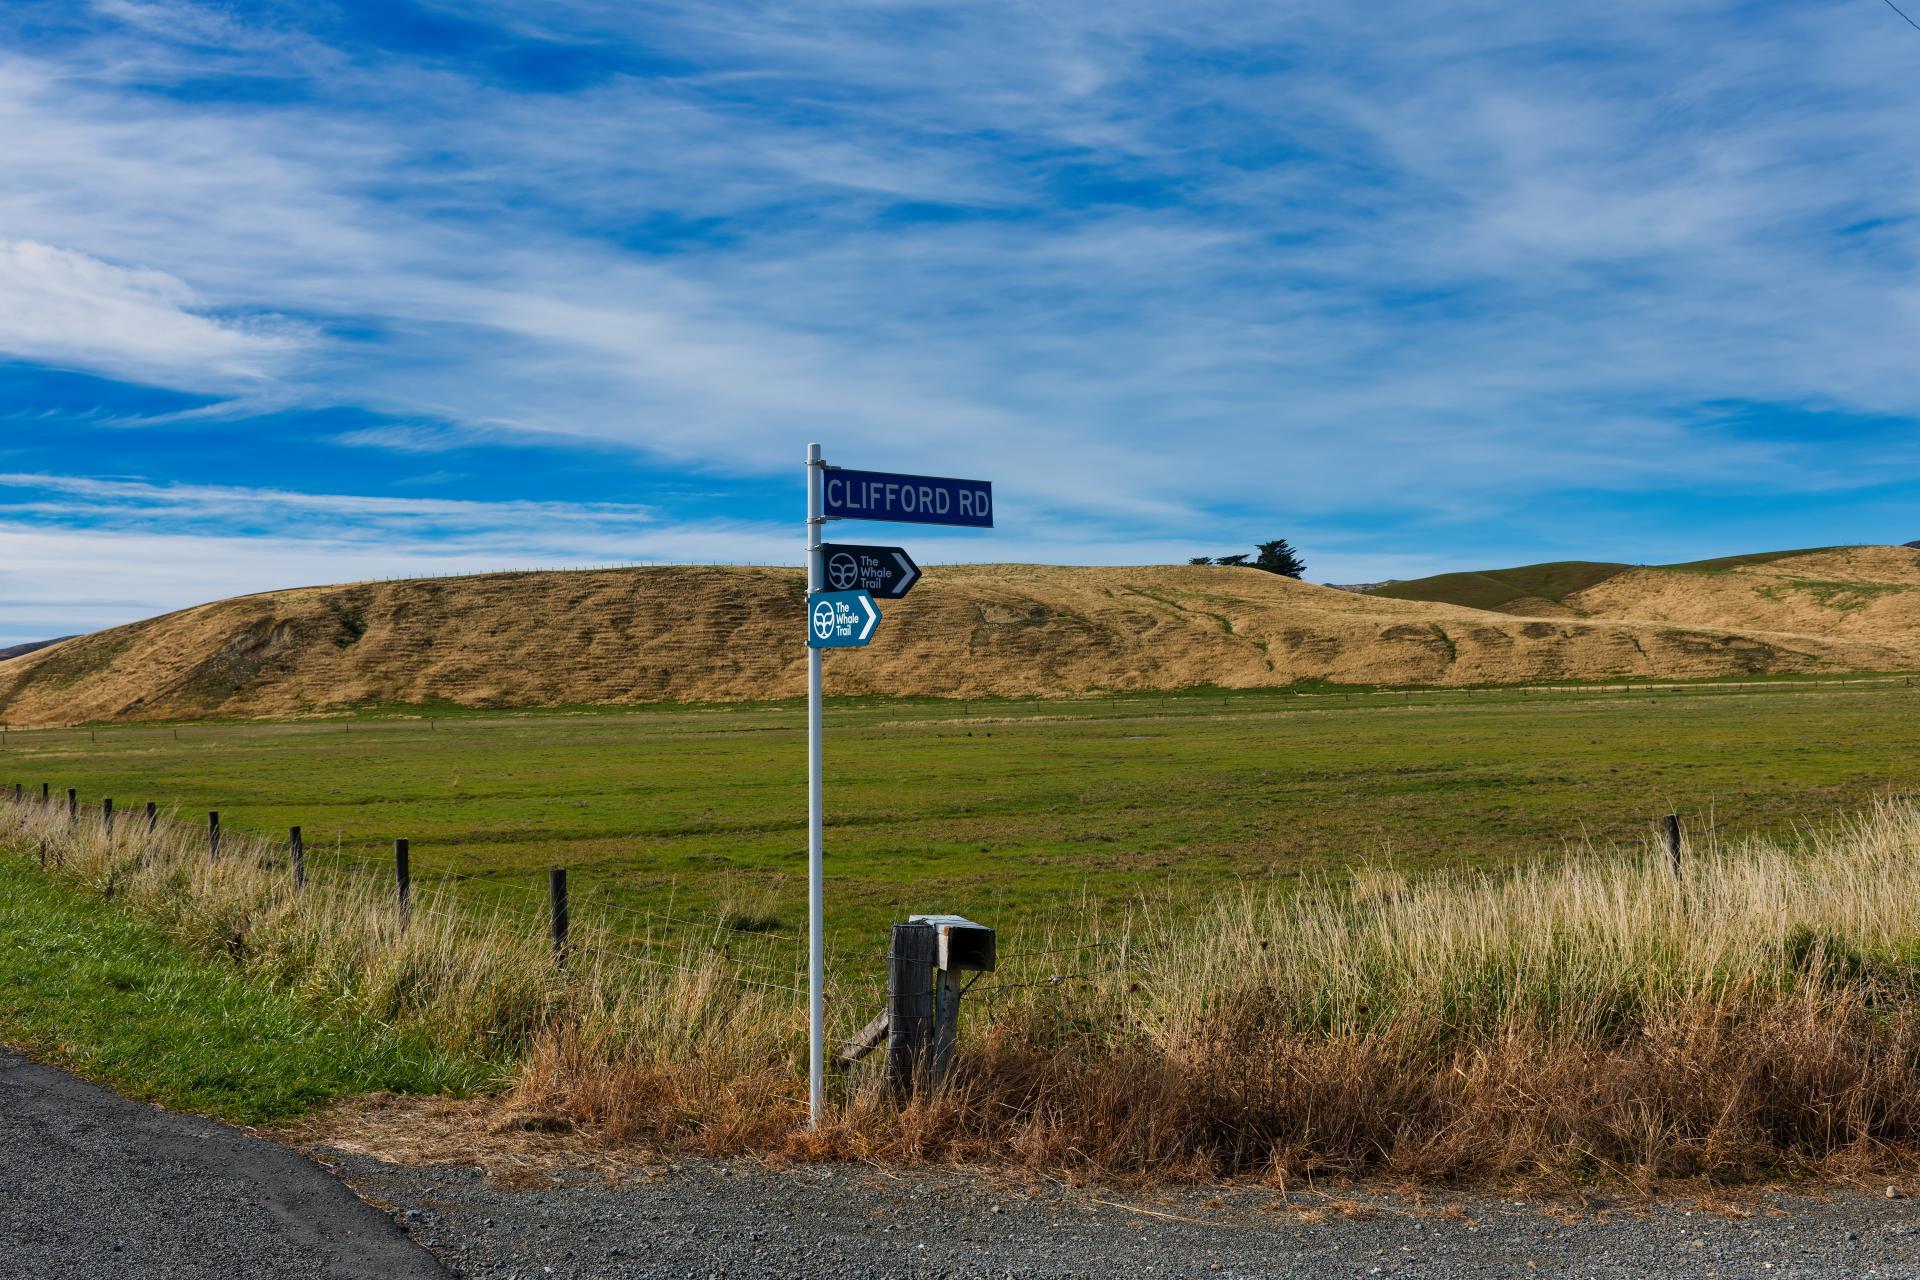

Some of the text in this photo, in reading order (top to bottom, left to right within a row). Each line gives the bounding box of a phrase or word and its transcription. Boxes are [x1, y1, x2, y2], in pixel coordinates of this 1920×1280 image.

[827, 479, 990, 517] CLIFFORD RD
[860, 555, 879, 567] The
[860, 567, 892, 578] Whale
[860, 578, 881, 589] Trail
[835, 601, 850, 613] The
[836, 612, 859, 624] Whale
[836, 624, 852, 637] Trail
